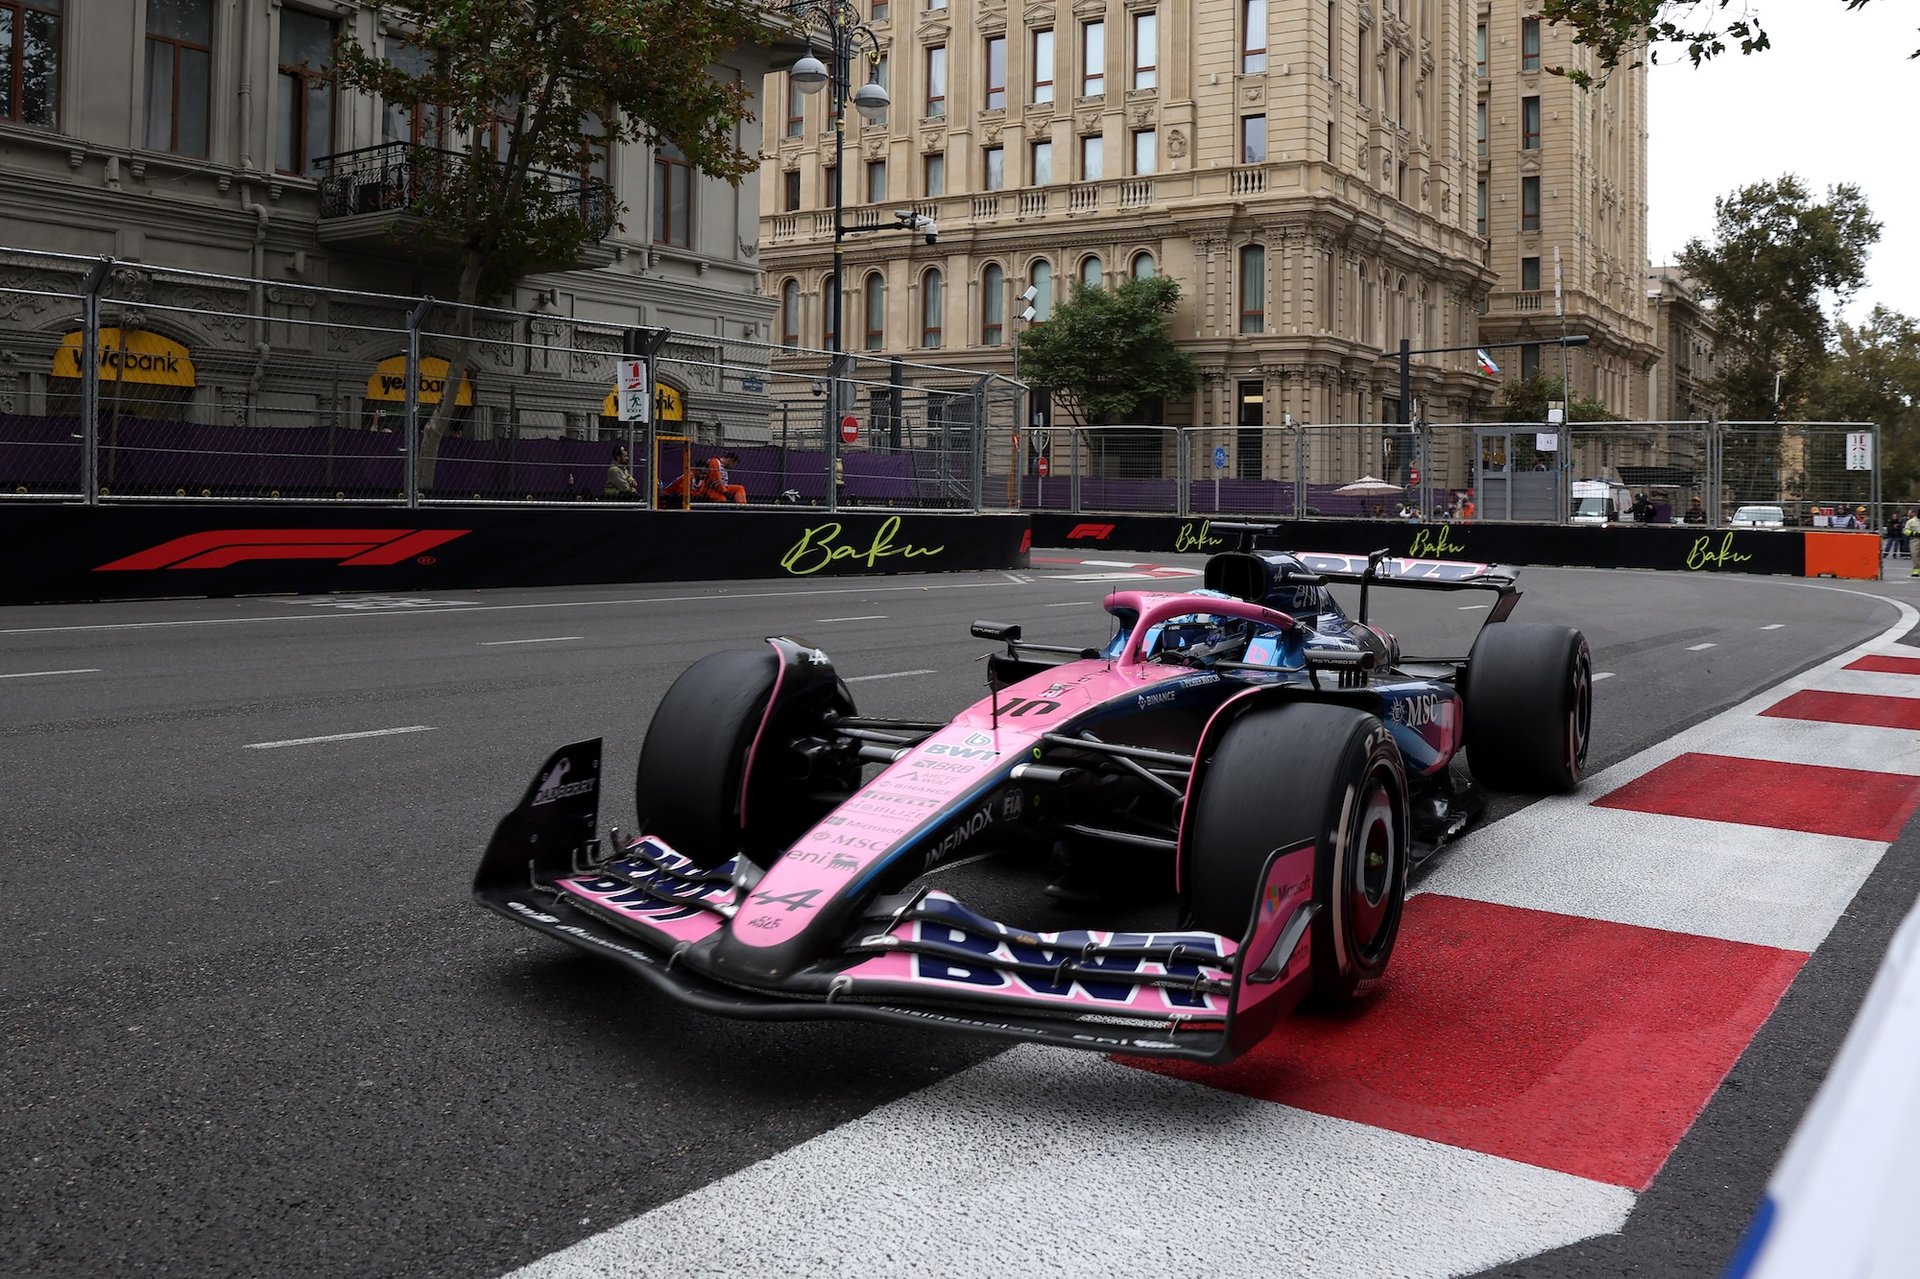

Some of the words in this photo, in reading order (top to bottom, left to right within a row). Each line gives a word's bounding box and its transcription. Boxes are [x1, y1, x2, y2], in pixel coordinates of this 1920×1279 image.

[1066, 523, 1117, 540] F1
[1175, 519, 1223, 553] Baku
[1409, 524, 1466, 558] Baku
[92, 528, 473, 571] F1
[781, 515, 945, 575] Baku
[1686, 531, 1753, 570] Baku
[989, 697, 1062, 717] 10
[1146, 690, 1176, 706] BINANCE
[1405, 693, 1440, 727] MSC
[924, 743, 997, 762] BWT
[935, 763, 976, 774] BRB
[860, 789, 941, 808] PIRELLI
[894, 783, 955, 796] BINANCE
[846, 820, 905, 835] Microsoft
[924, 802, 993, 868] INFINOX
[831, 835, 890, 851] MSC
[787, 850, 830, 865] eni
[916, 896, 1220, 1010] BWT
